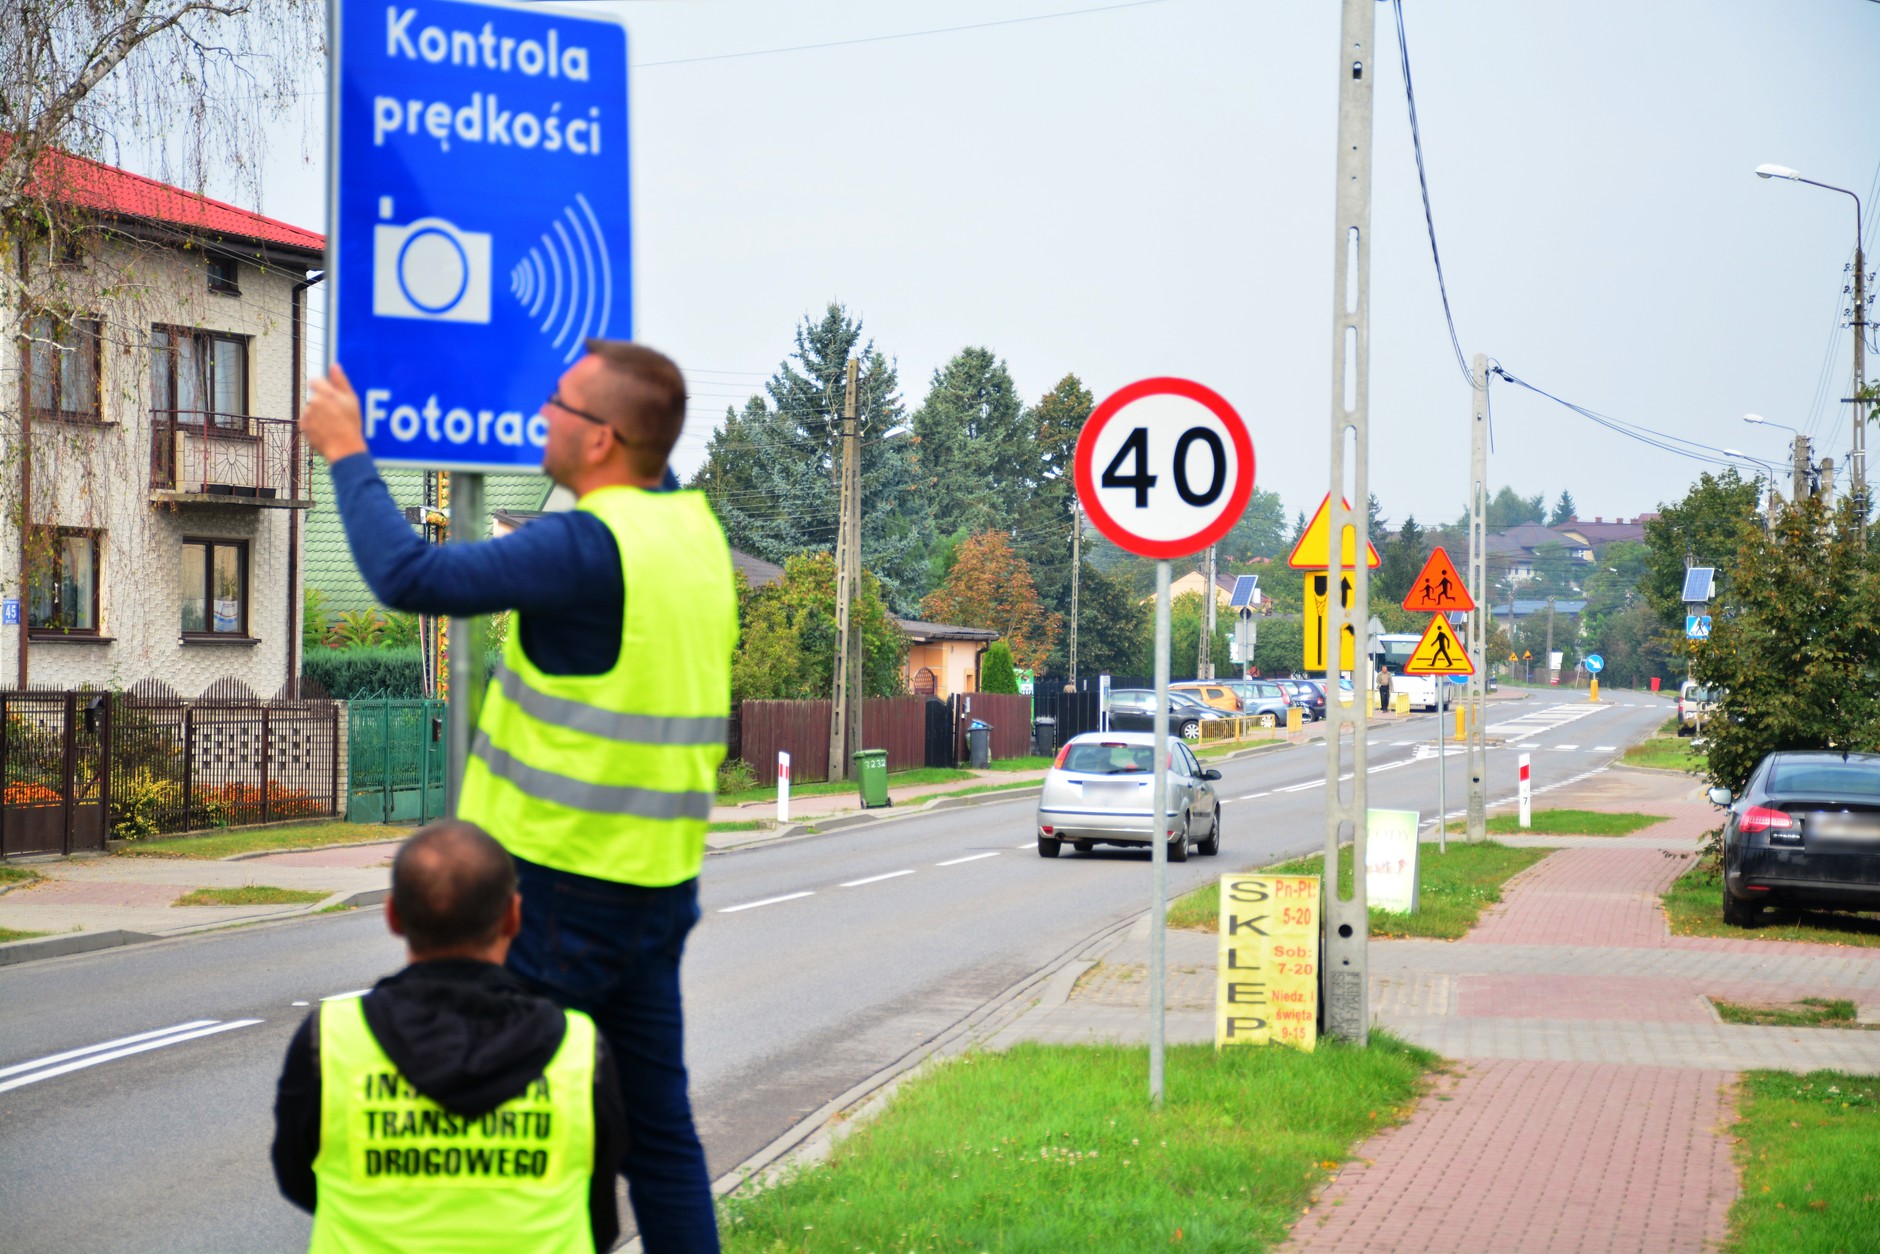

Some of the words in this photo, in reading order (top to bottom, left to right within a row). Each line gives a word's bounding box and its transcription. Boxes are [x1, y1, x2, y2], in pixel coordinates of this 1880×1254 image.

[386, 5, 590, 82] Kontrola
[373, 91, 601, 156] prędkości
[1101, 426, 1227, 508] 40
[5, 604, 17, 619] 45
[864, 760, 886, 769] 3232
[1275, 880, 1317, 898] Pn-Pt:
[1283, 907, 1311, 925] 5-20
[1226, 880, 1271, 1038] SKLEP
[1274, 945, 1313, 958] Sob:
[1278, 963, 1313, 975] 7-20
[1271, 990, 1307, 1003] Niedz.
[1310, 991, 1315, 1002] i
[1276, 1008, 1313, 1024] święta
[1281, 1027, 1306, 1039] 9-15
[366, 1148, 548, 1178] DROGOWEGO
